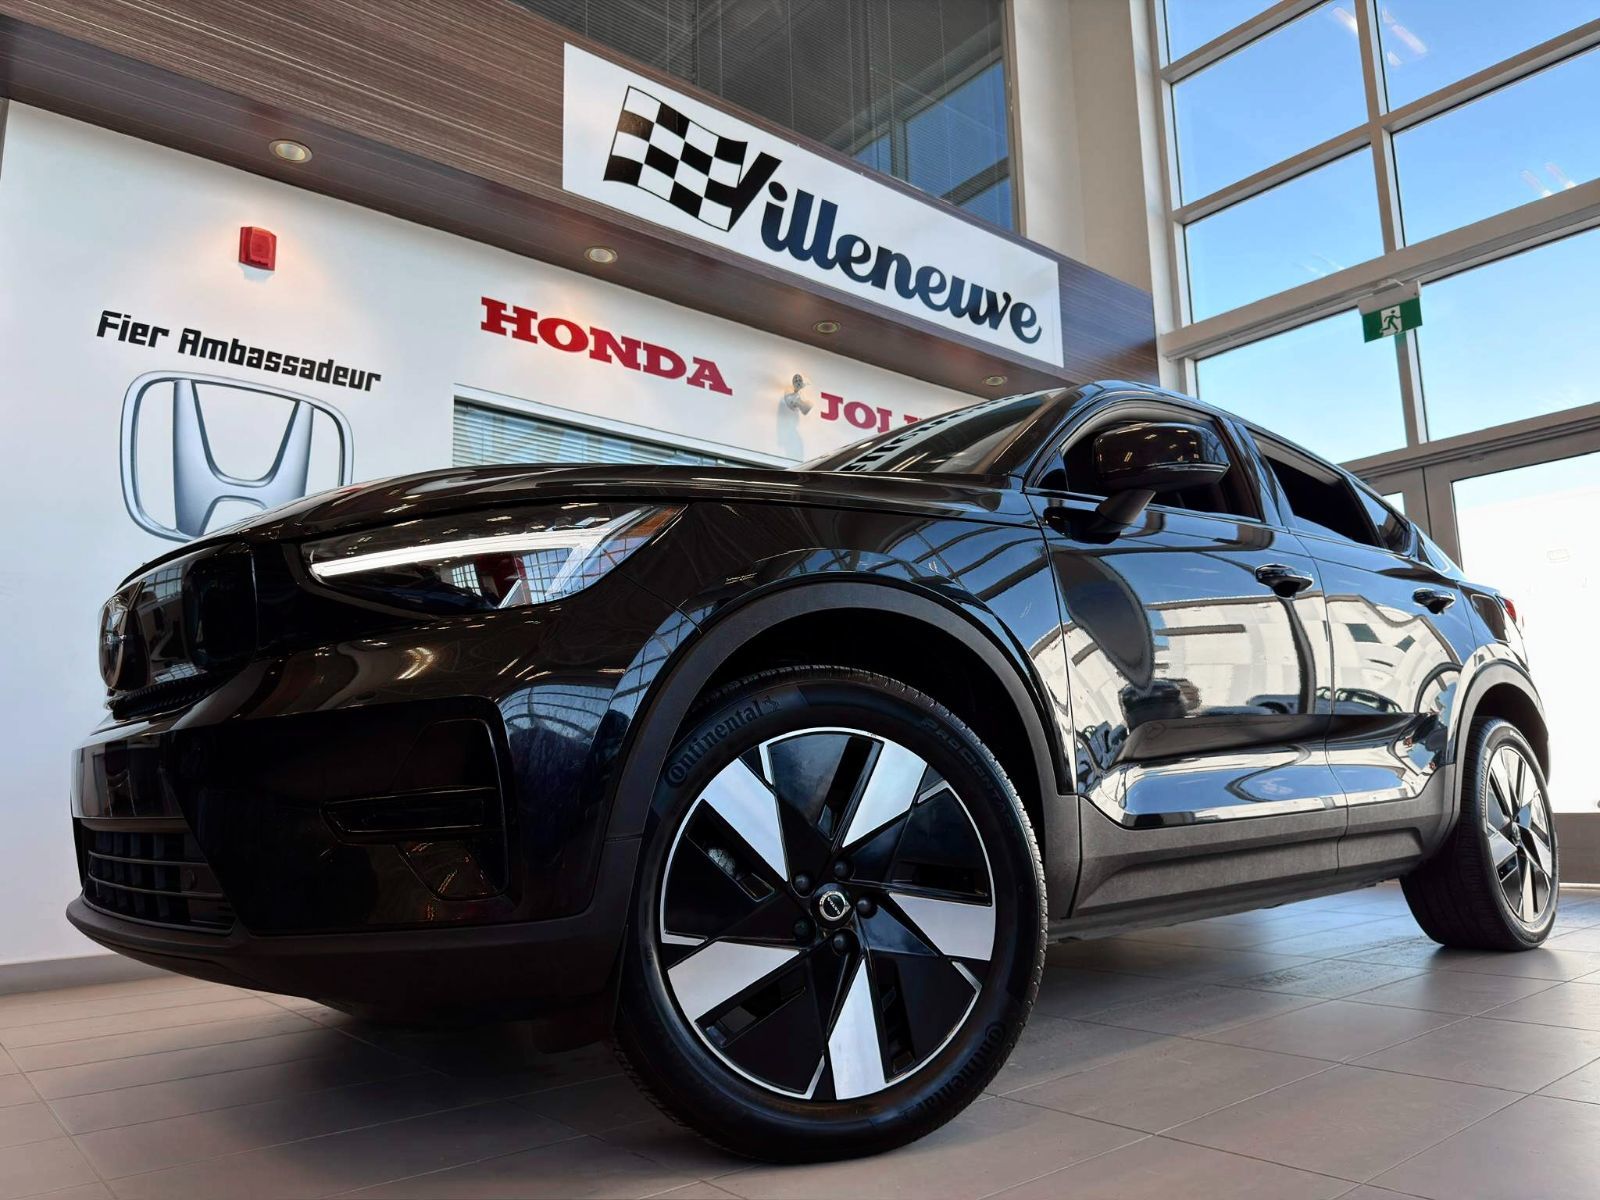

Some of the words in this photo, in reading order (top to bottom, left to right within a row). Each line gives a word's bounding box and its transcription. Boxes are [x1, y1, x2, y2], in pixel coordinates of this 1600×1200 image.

[702, 141, 1042, 344] Villeneuve
[96, 310, 170, 348] Fier
[177, 327, 382, 392] Ambassadeur
[480, 296, 733, 396] HONDA
[664, 700, 763, 786] Continental
